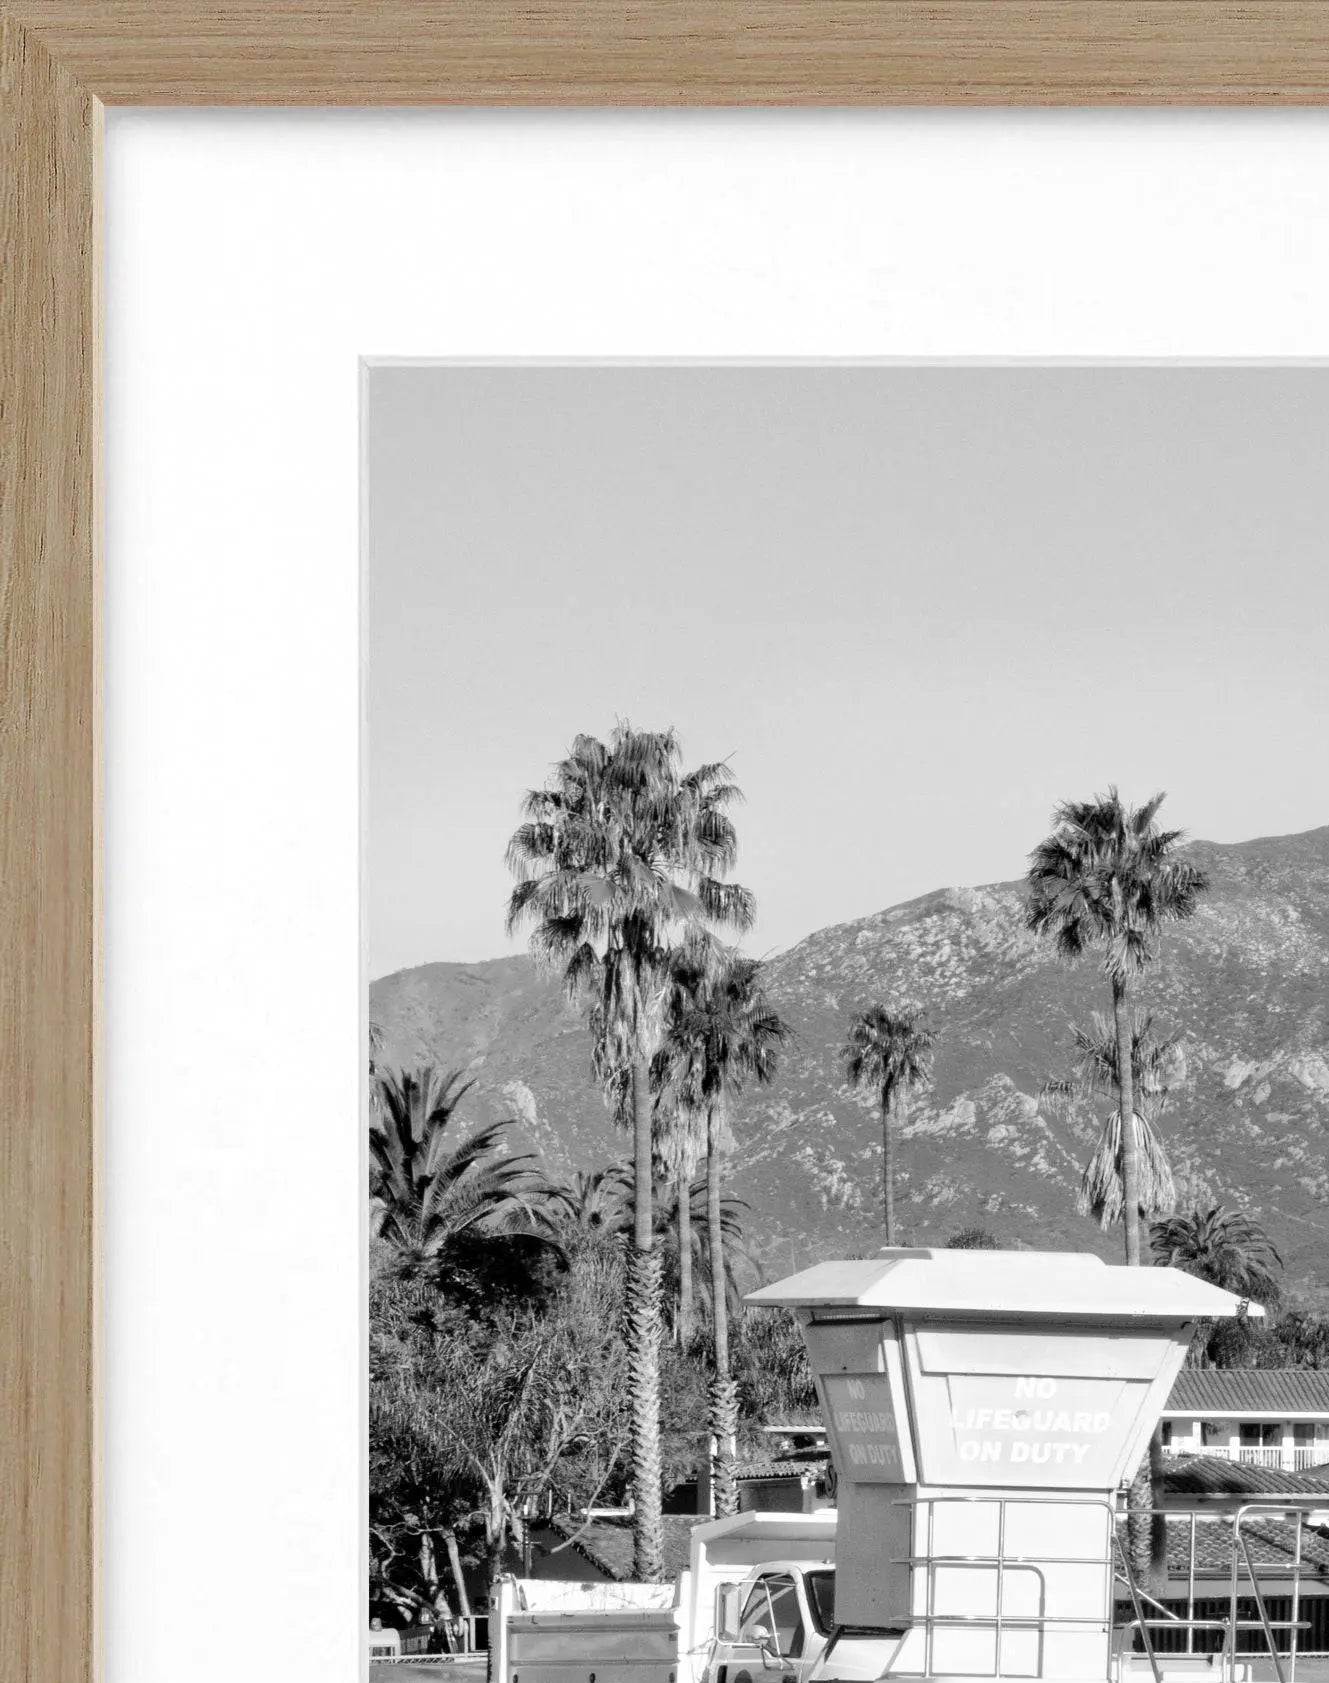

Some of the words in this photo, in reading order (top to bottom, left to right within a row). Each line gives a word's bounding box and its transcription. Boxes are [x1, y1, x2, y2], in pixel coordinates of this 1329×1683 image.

[846, 1378, 866, 1400] NO
[1014, 1377, 1057, 1400] NO
[948, 1408, 1111, 1433] LIFEGUARD
[848, 1443, 868, 1465] ON
[867, 1443, 898, 1466] DUTY
[959, 1440, 1003, 1463] ON
[1010, 1440, 1092, 1464] DUTY
